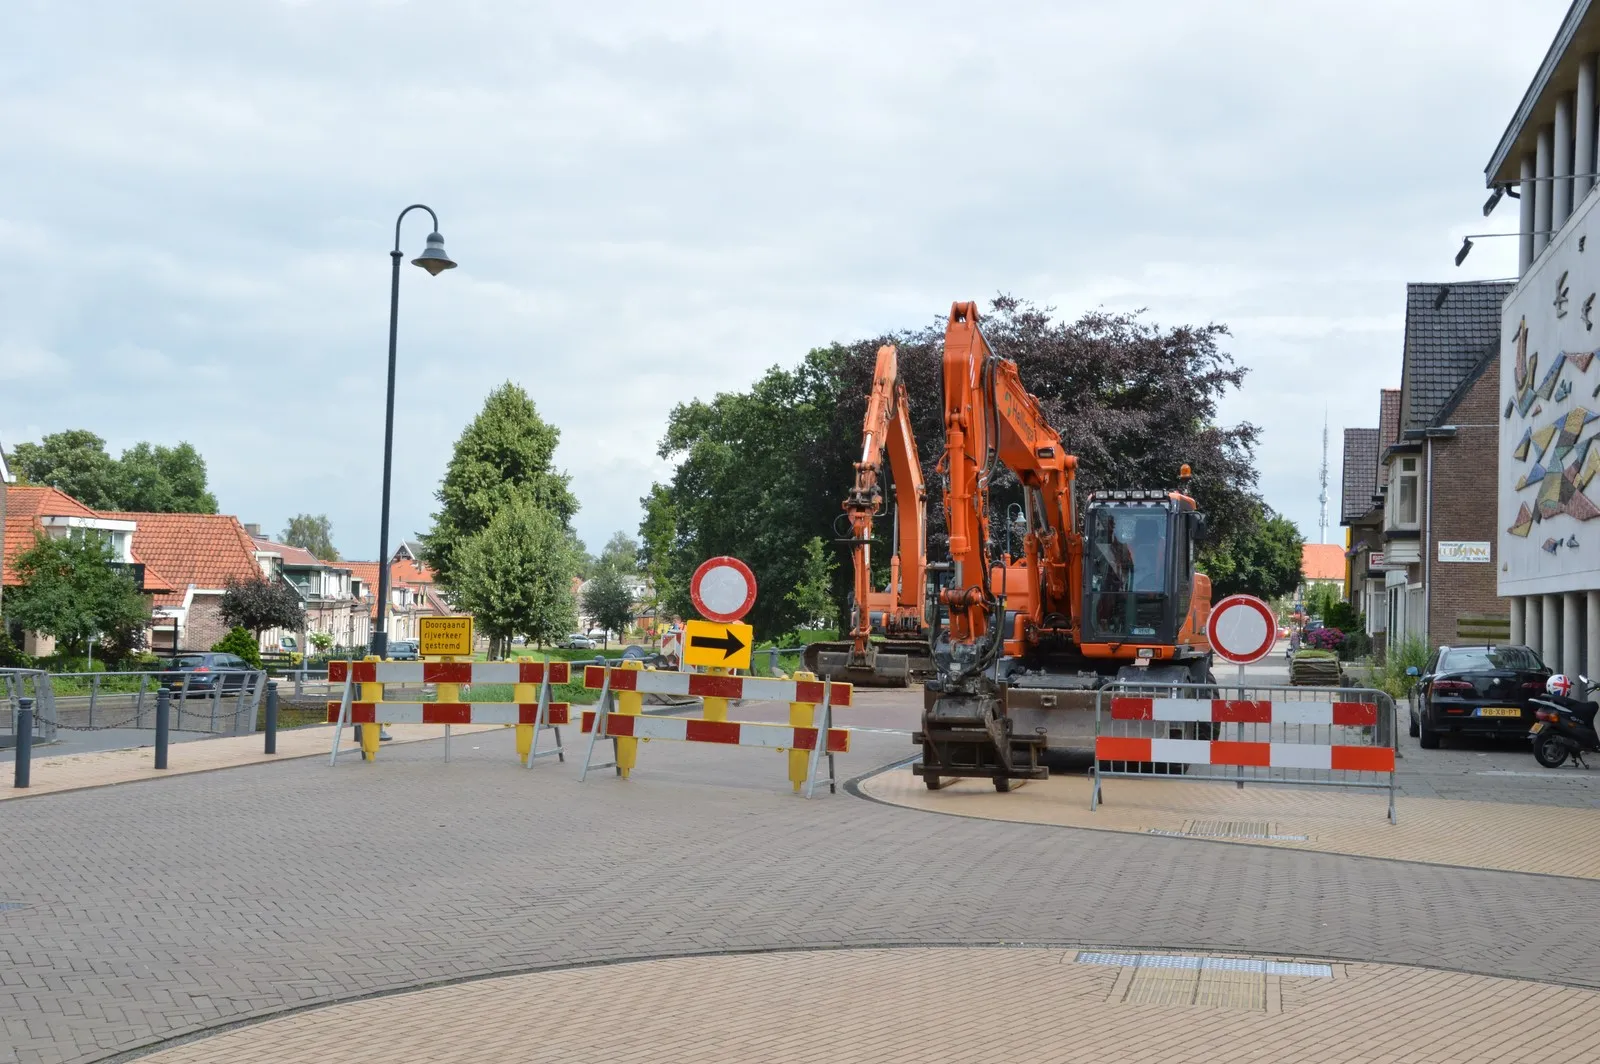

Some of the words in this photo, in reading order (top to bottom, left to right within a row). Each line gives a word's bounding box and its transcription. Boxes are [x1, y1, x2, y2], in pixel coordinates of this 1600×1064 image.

[425, 621, 466, 630] Doorgaand
[424, 632, 462, 640] rijverkeer
[425, 642, 461, 651] gestremd
[1482, 708, 1517, 716] 98-XB-PT
